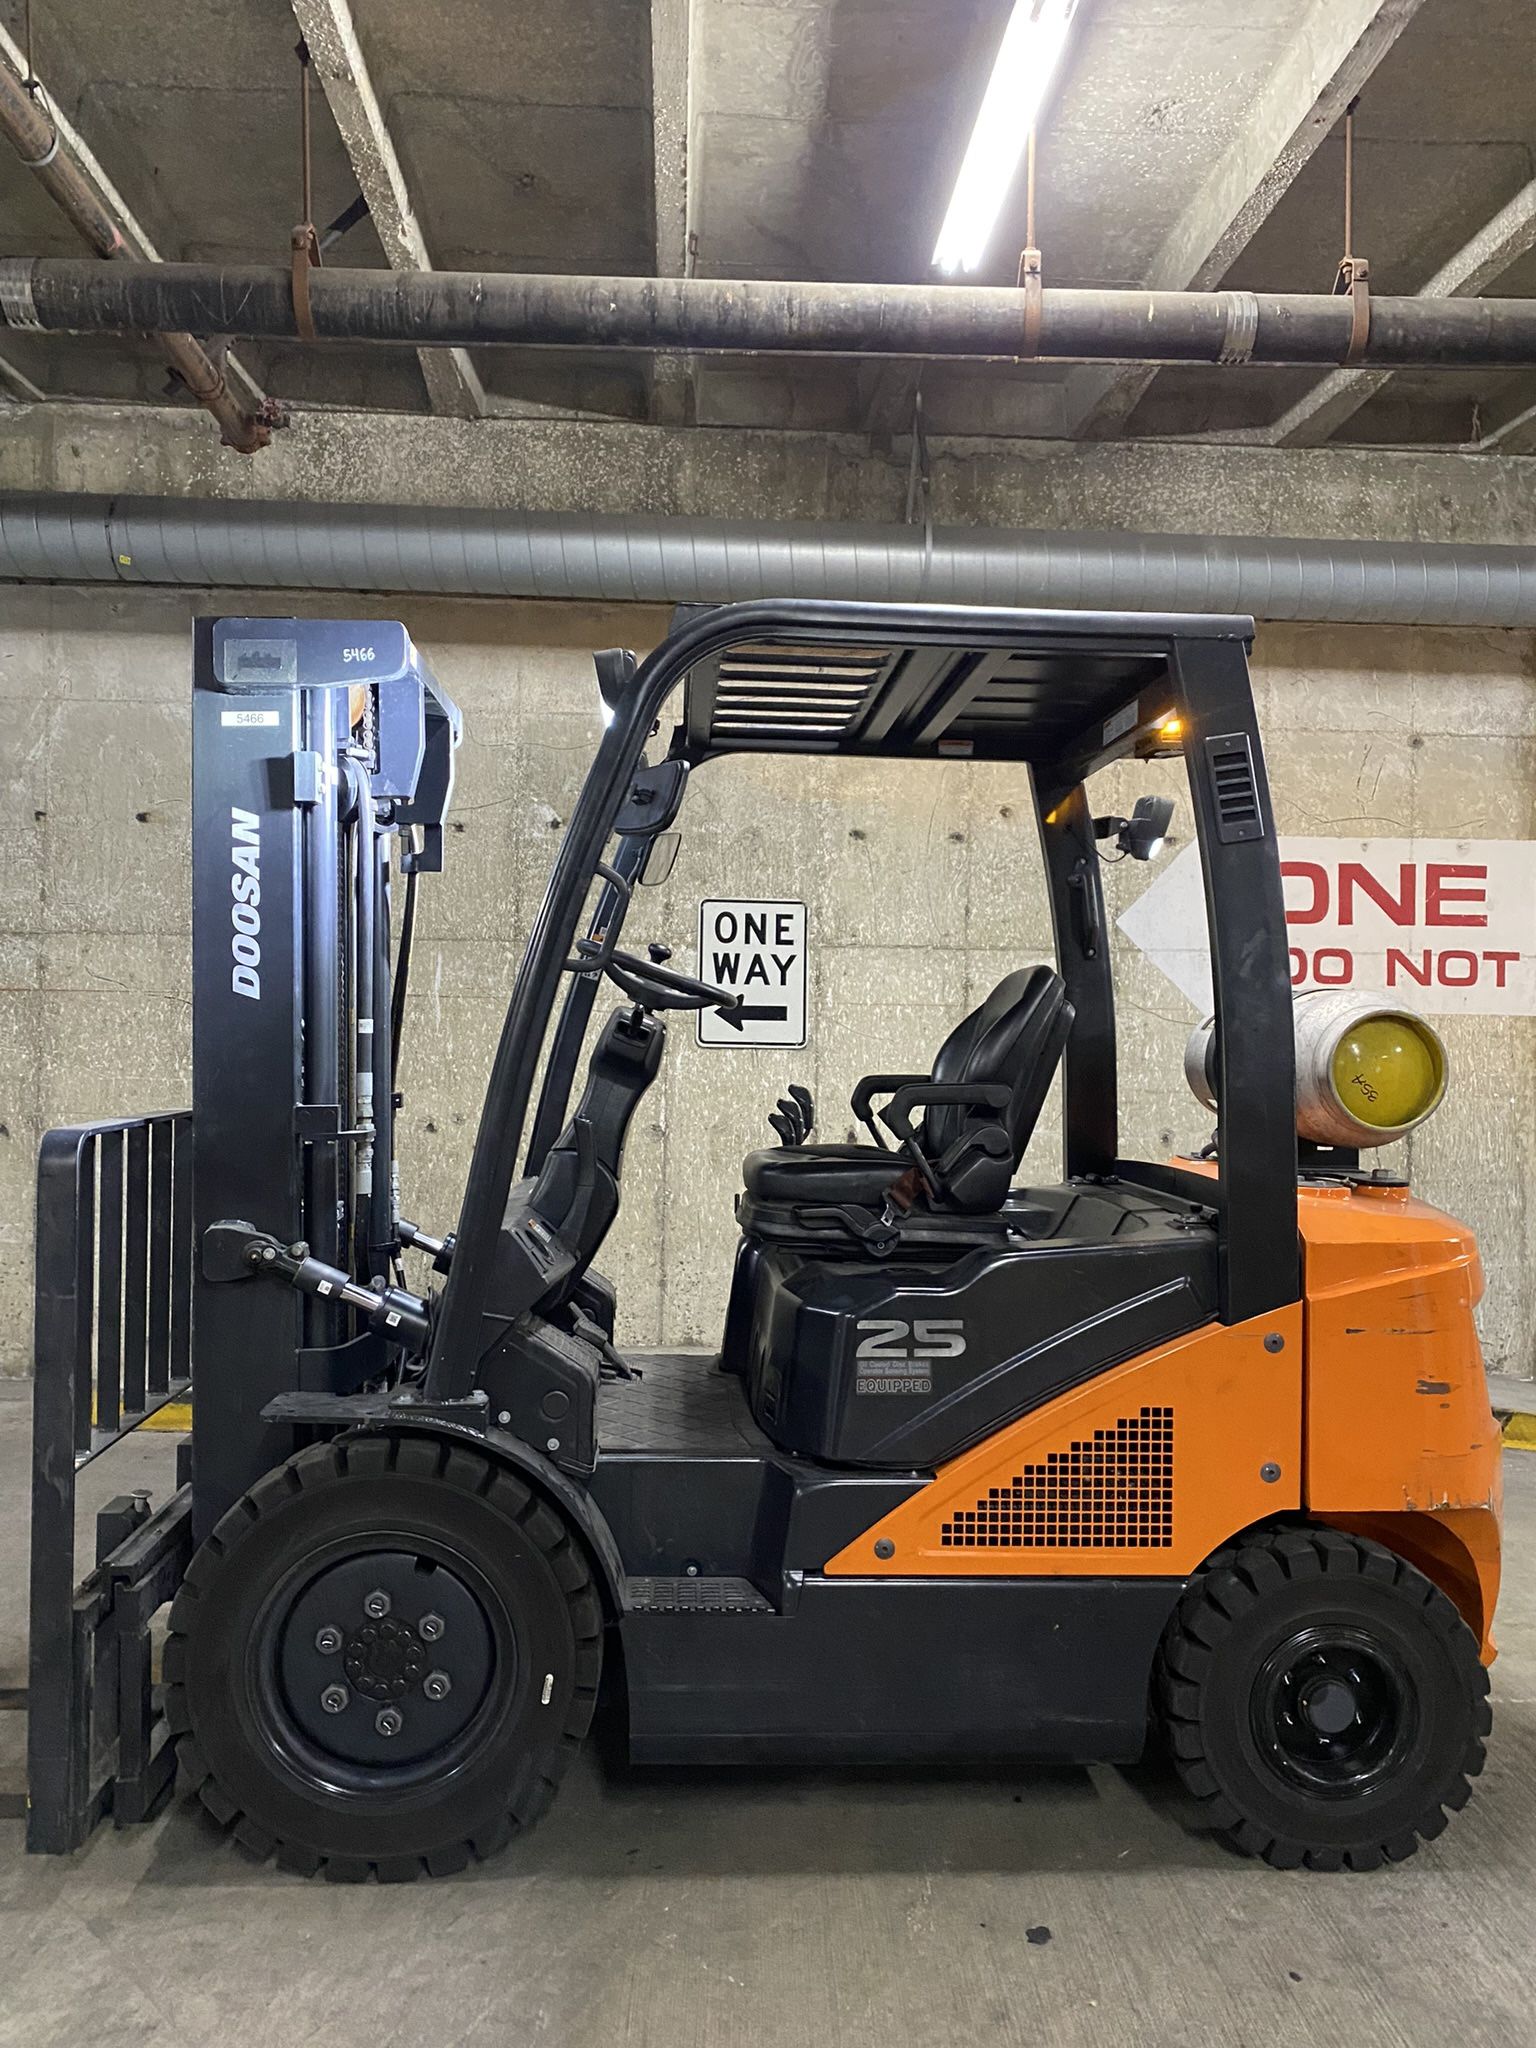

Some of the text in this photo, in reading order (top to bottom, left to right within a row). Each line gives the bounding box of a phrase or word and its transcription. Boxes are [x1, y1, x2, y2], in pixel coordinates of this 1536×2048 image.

[343, 647, 376, 662] 5466
[236, 713, 264, 723] 5466
[231, 806, 260, 1000] DOOSAN
[1280, 861, 1488, 927] ONE
[715, 911, 794, 945] ONE
[713, 952, 797, 986] WAY
[1386, 948, 1520, 987] NOT
[856, 1320, 966, 1358] 25
[857, 1379, 932, 1394] EQUIPPED
